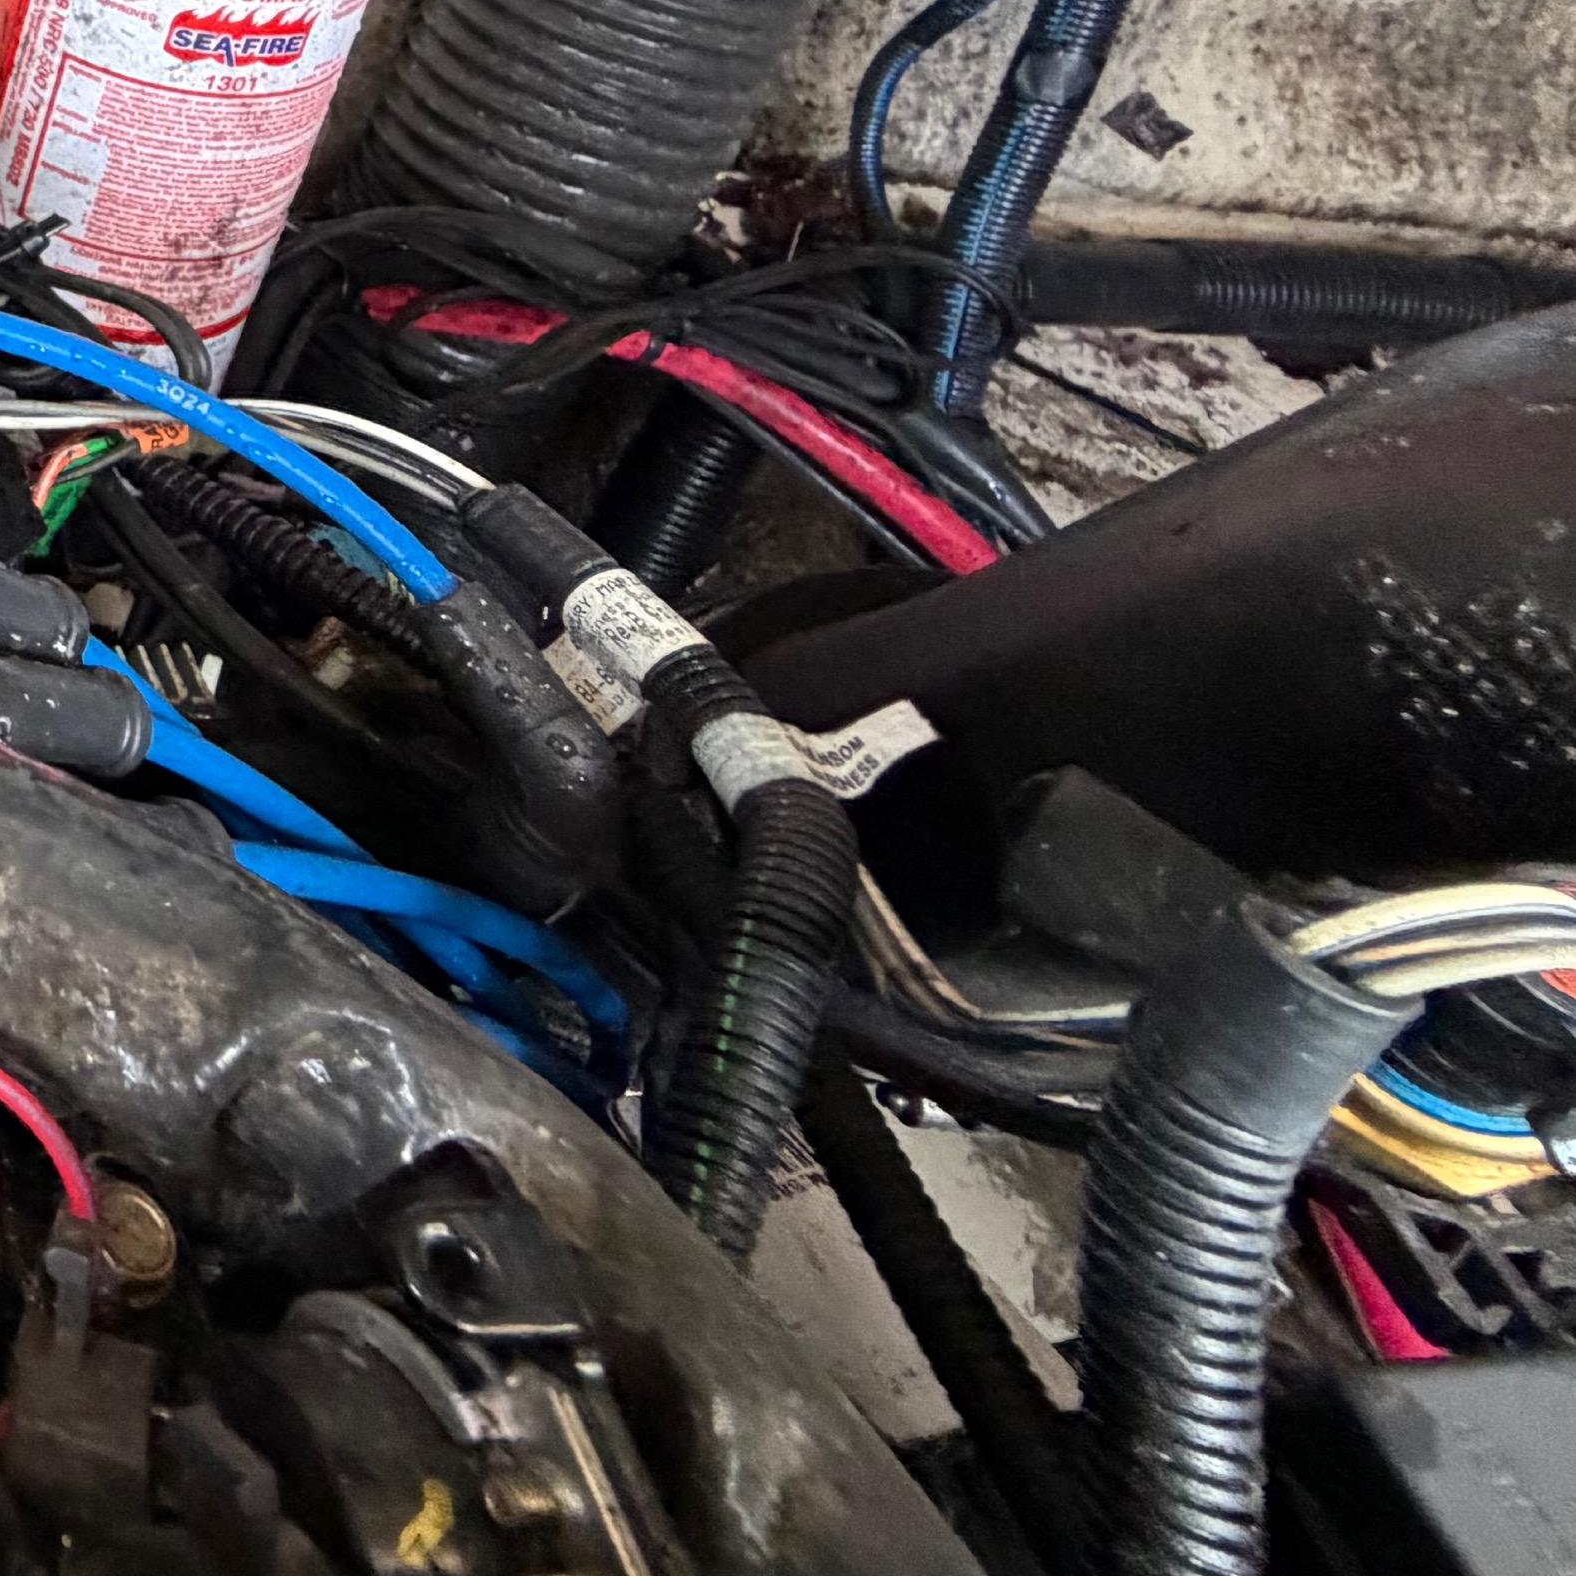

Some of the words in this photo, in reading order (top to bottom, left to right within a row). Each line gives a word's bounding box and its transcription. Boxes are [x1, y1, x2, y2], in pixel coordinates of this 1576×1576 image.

[42, 11, 66, 55] NRC
[173, 28, 304, 67] SEA-FIRE
[205, 75, 257, 93] 1301
